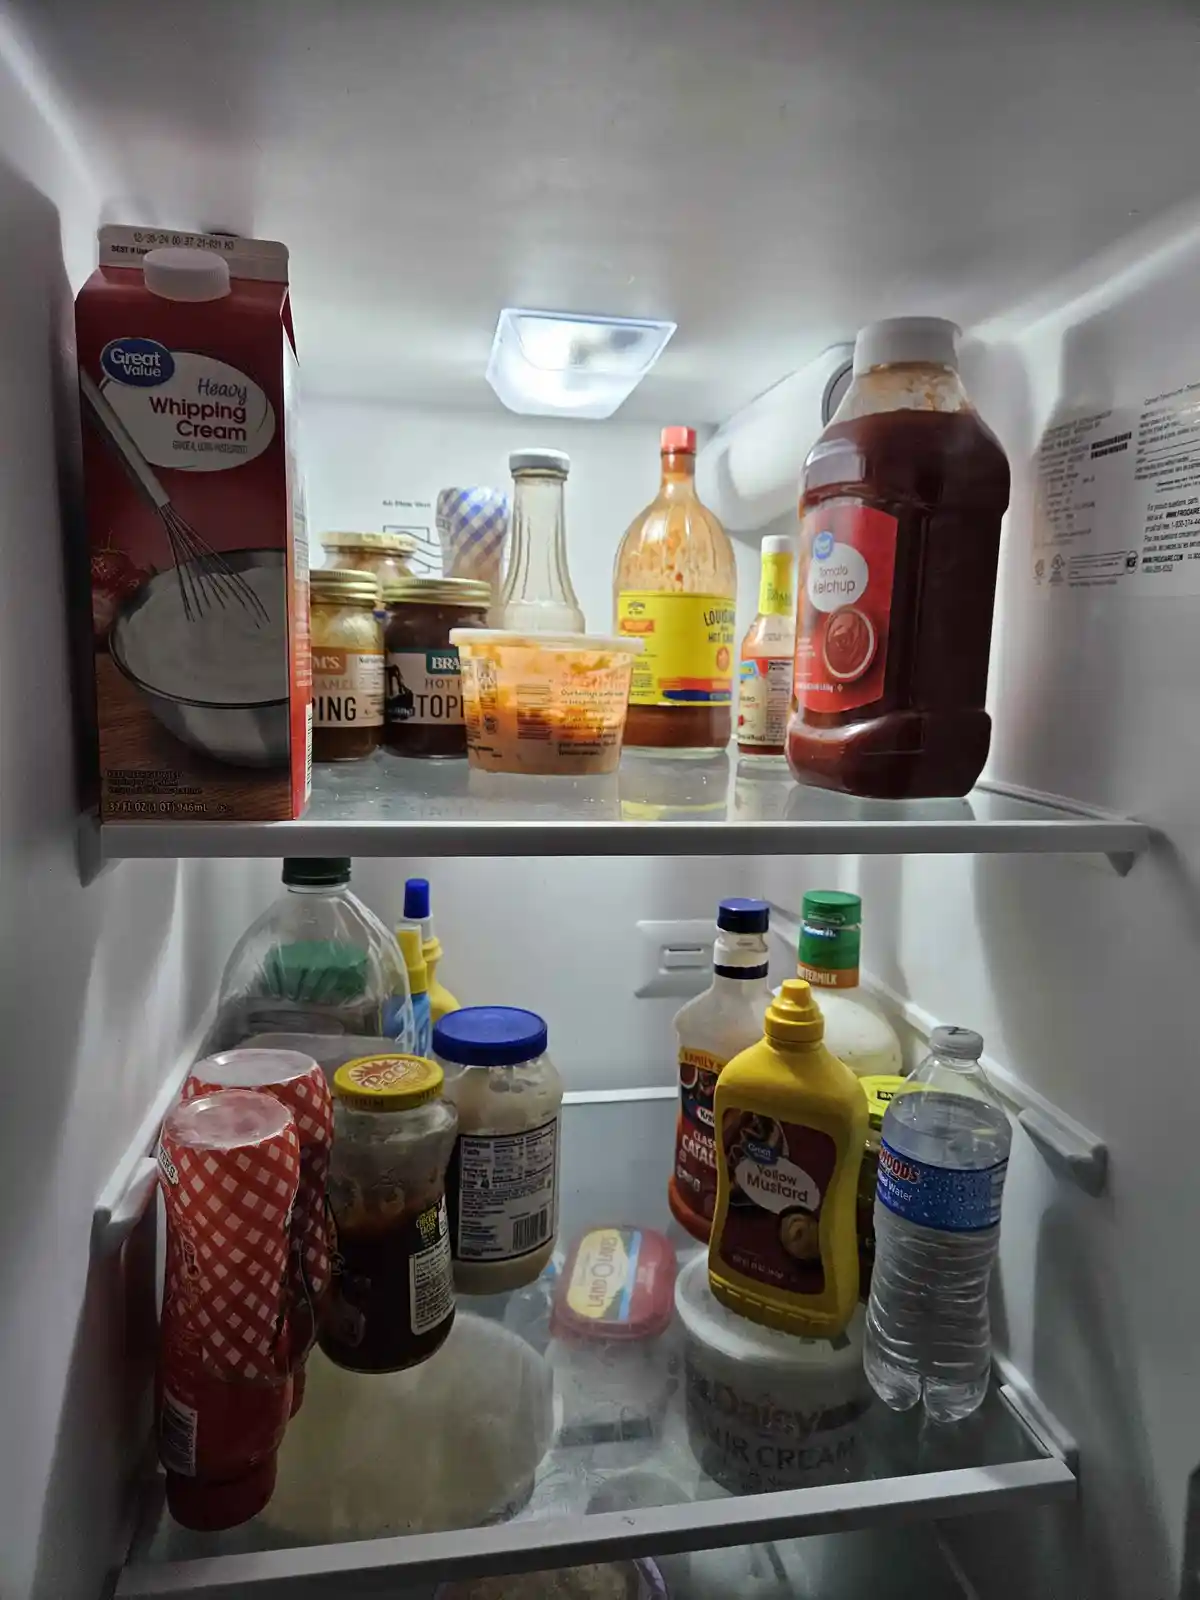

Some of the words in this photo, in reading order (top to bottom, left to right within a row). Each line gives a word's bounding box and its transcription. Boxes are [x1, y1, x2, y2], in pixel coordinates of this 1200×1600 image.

[110, 348, 161, 367] Great
[123, 364, 162, 377] Value
[198, 378, 248, 405] Heavy
[150, 396, 247, 424] Whipping
[176, 420, 247, 441] Cream
[431, 656, 461, 670] BRA
[425, 678, 452, 690] HOT
[700, 1107, 715, 1124] Kra
[682, 1133, 718, 1168] CATAL
[756, 1163, 798, 1187] Yellow
[746, 1171, 809, 1204] Mustard
[888, 1181, 913, 1202] Water
[591, 1262, 615, 1278] O
[586, 1278, 608, 1308] LAND
[755, 1435, 856, 1472] CREAM
